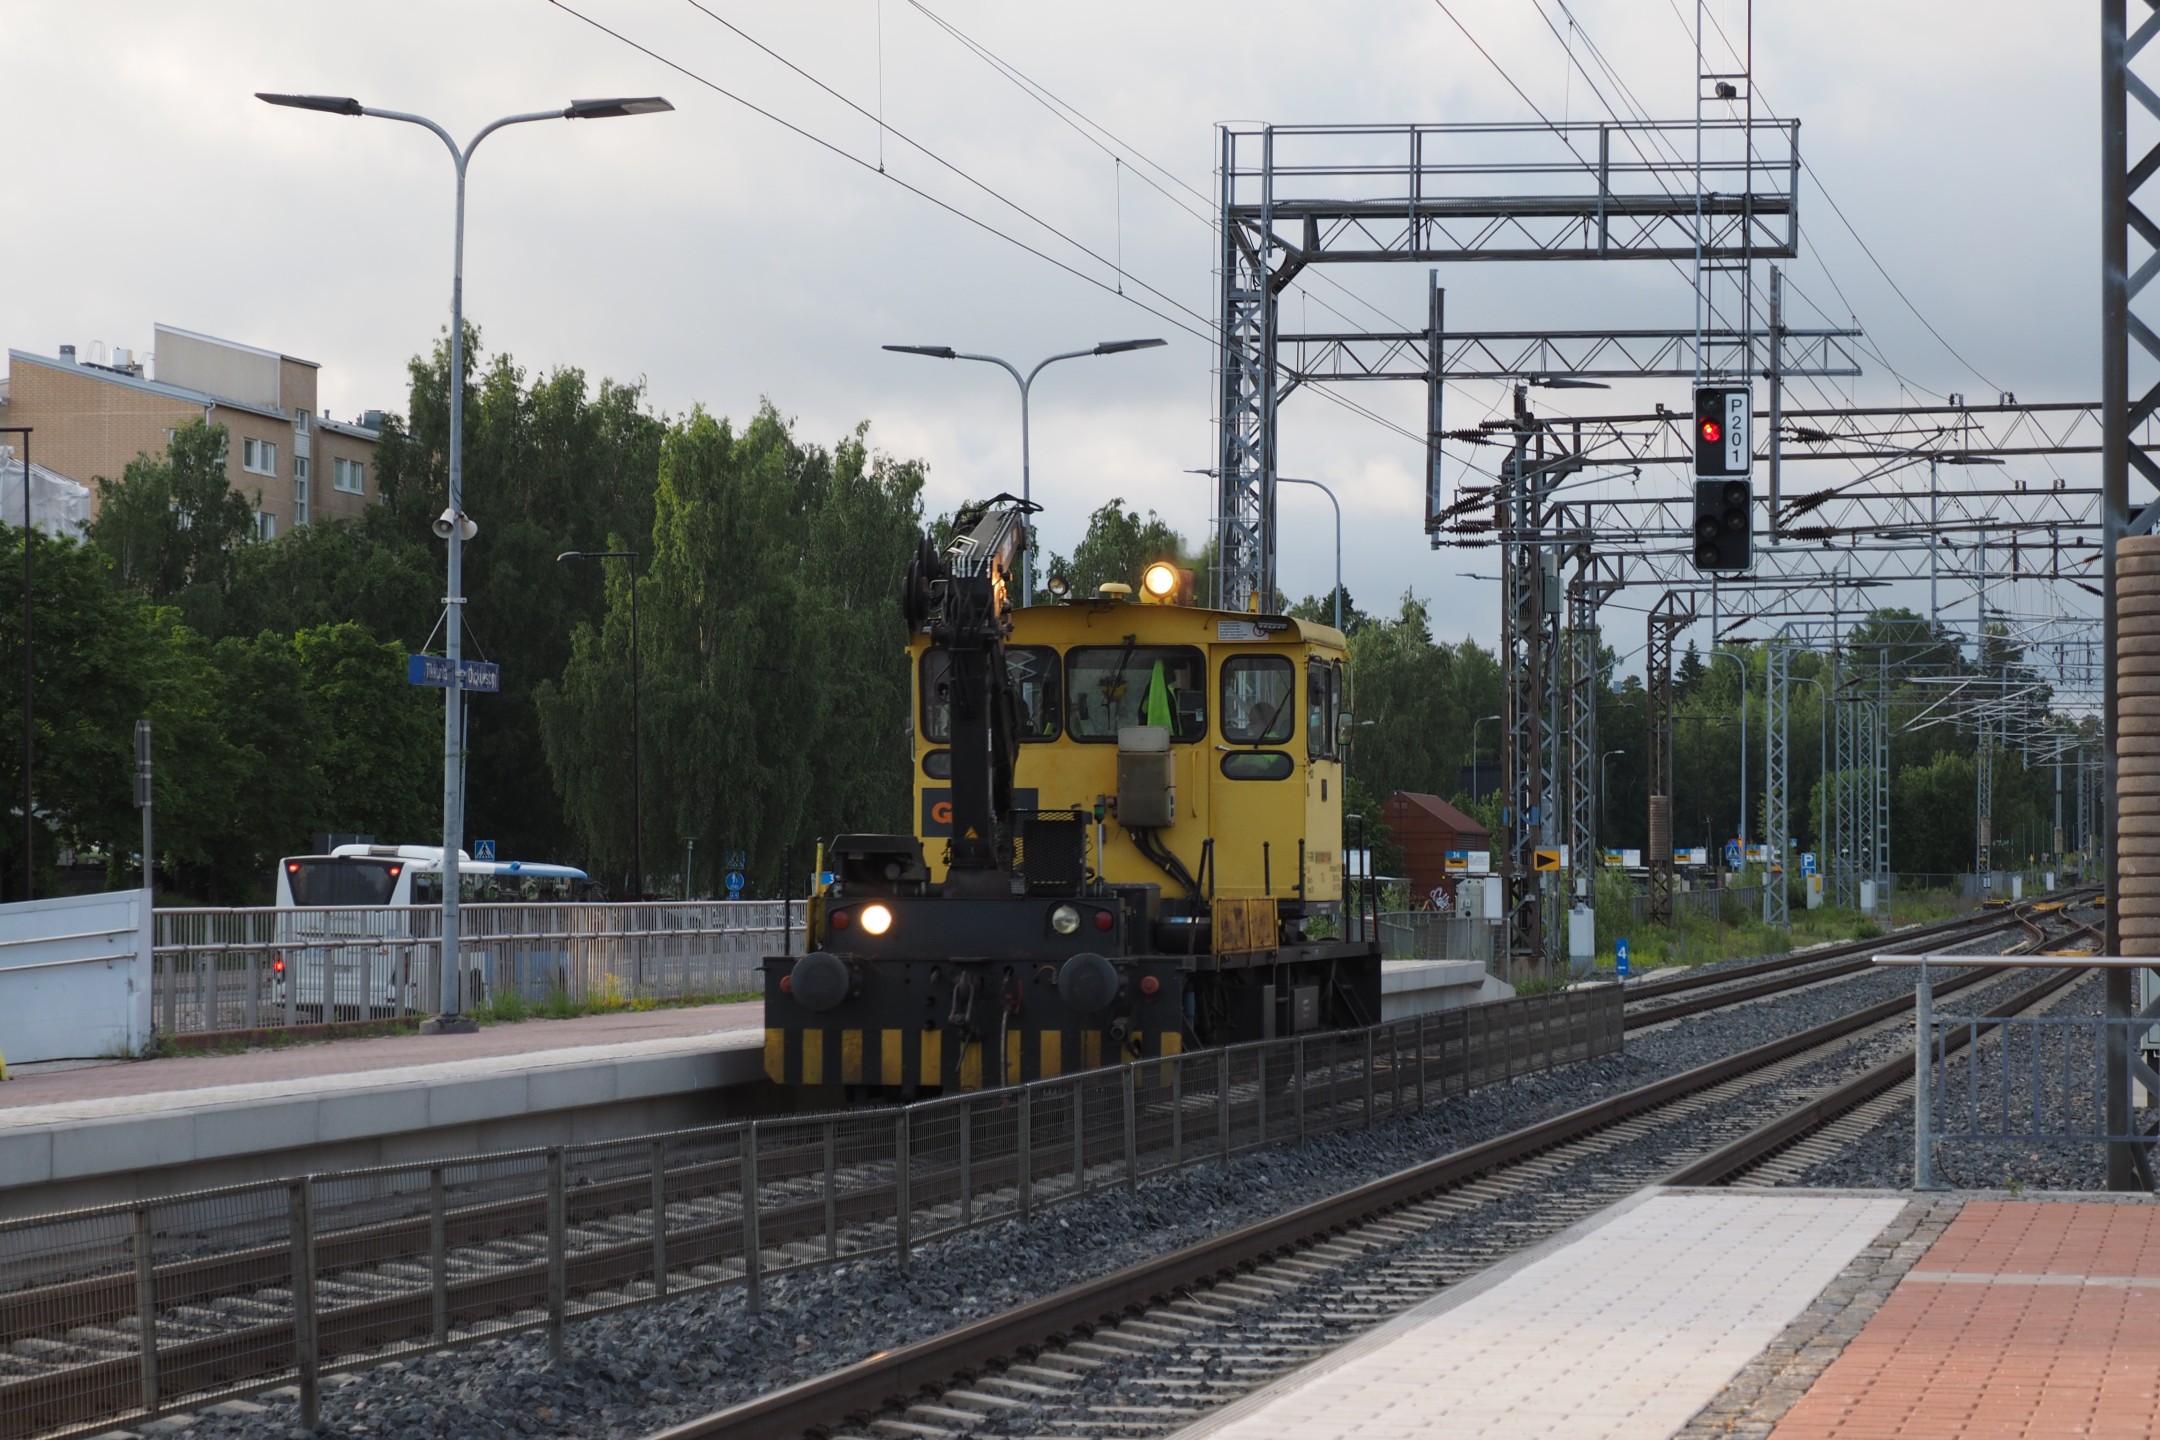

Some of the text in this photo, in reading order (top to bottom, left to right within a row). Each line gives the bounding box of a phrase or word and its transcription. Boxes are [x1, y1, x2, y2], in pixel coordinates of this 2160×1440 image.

[1731, 399, 1743, 463] P201
[1803, 854, 1814, 867] P
[1617, 946, 1627, 960] 4
